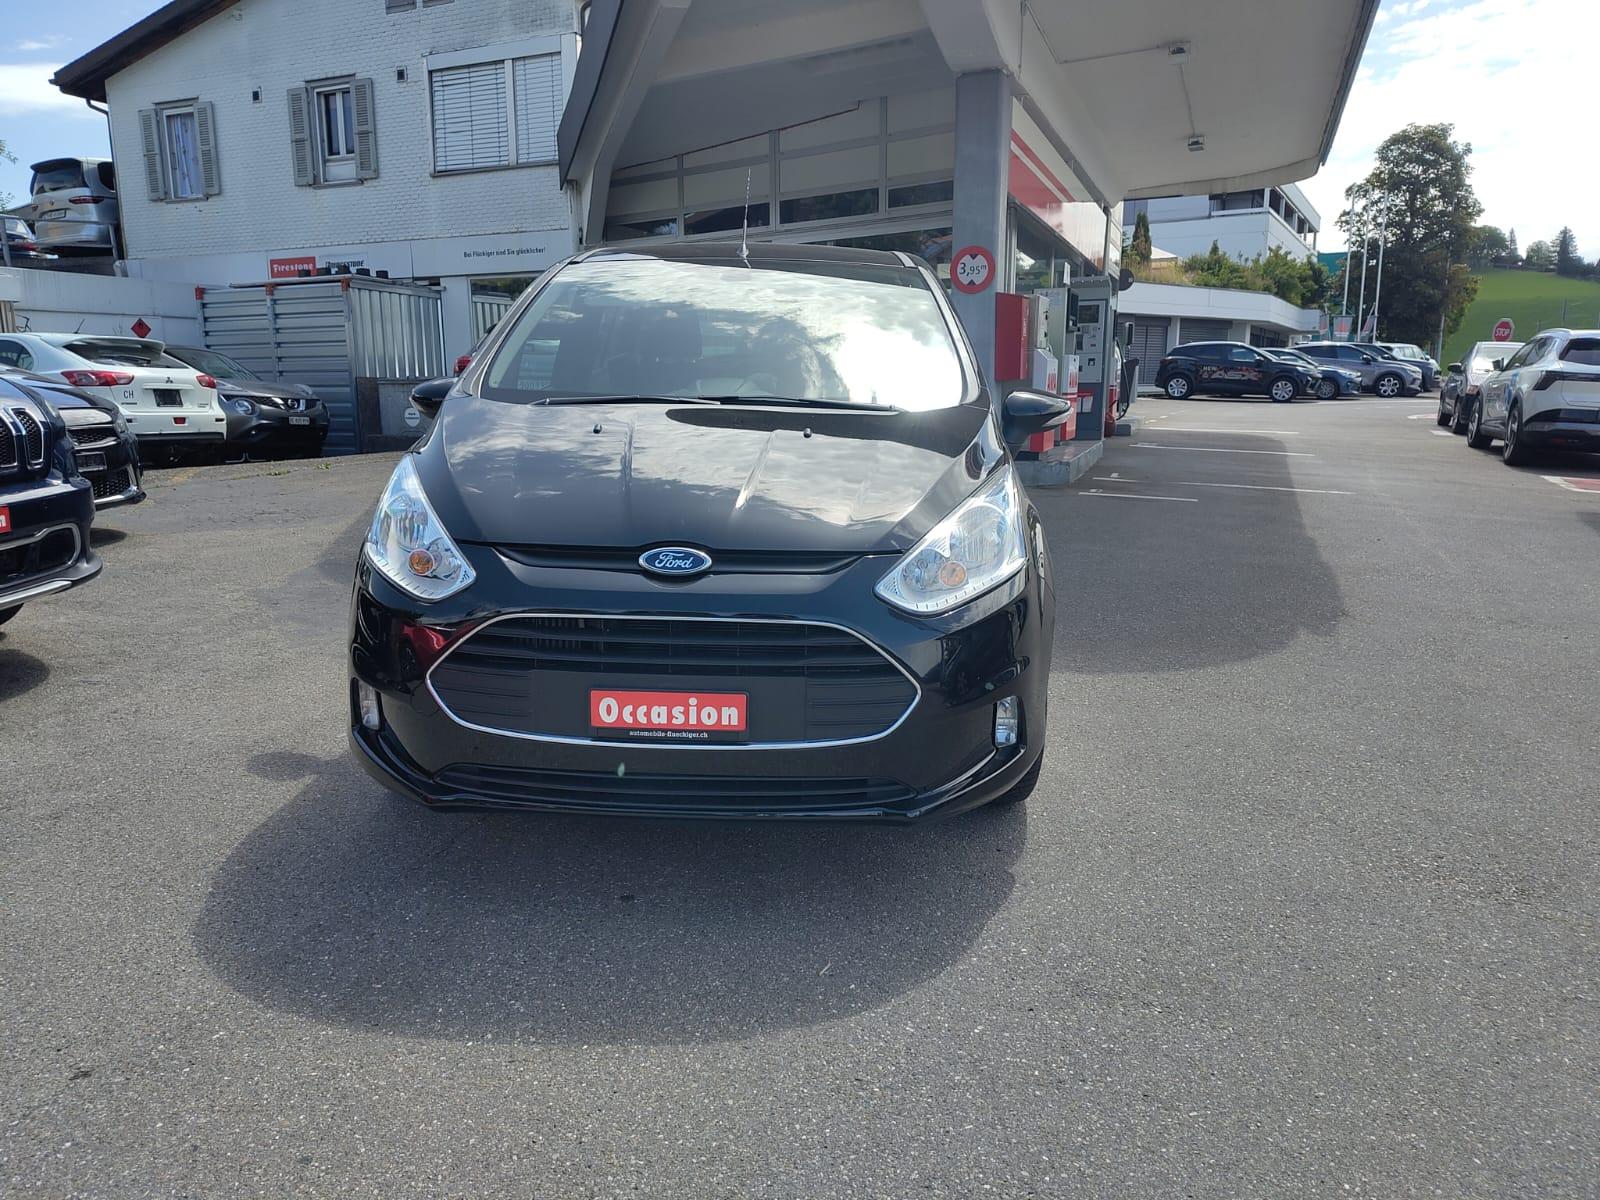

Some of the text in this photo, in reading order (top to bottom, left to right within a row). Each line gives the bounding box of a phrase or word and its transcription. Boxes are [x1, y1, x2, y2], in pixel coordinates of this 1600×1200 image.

[496, 248, 506, 256] und
[273, 262, 313, 273] Firestone
[1495, 327, 1511, 337] STOP
[123, 390, 134, 399] CH
[655, 552, 694, 568] Ford
[599, 697, 739, 726] Occasion
[629, 730, 708, 739] automobile-flueckiger.ch
